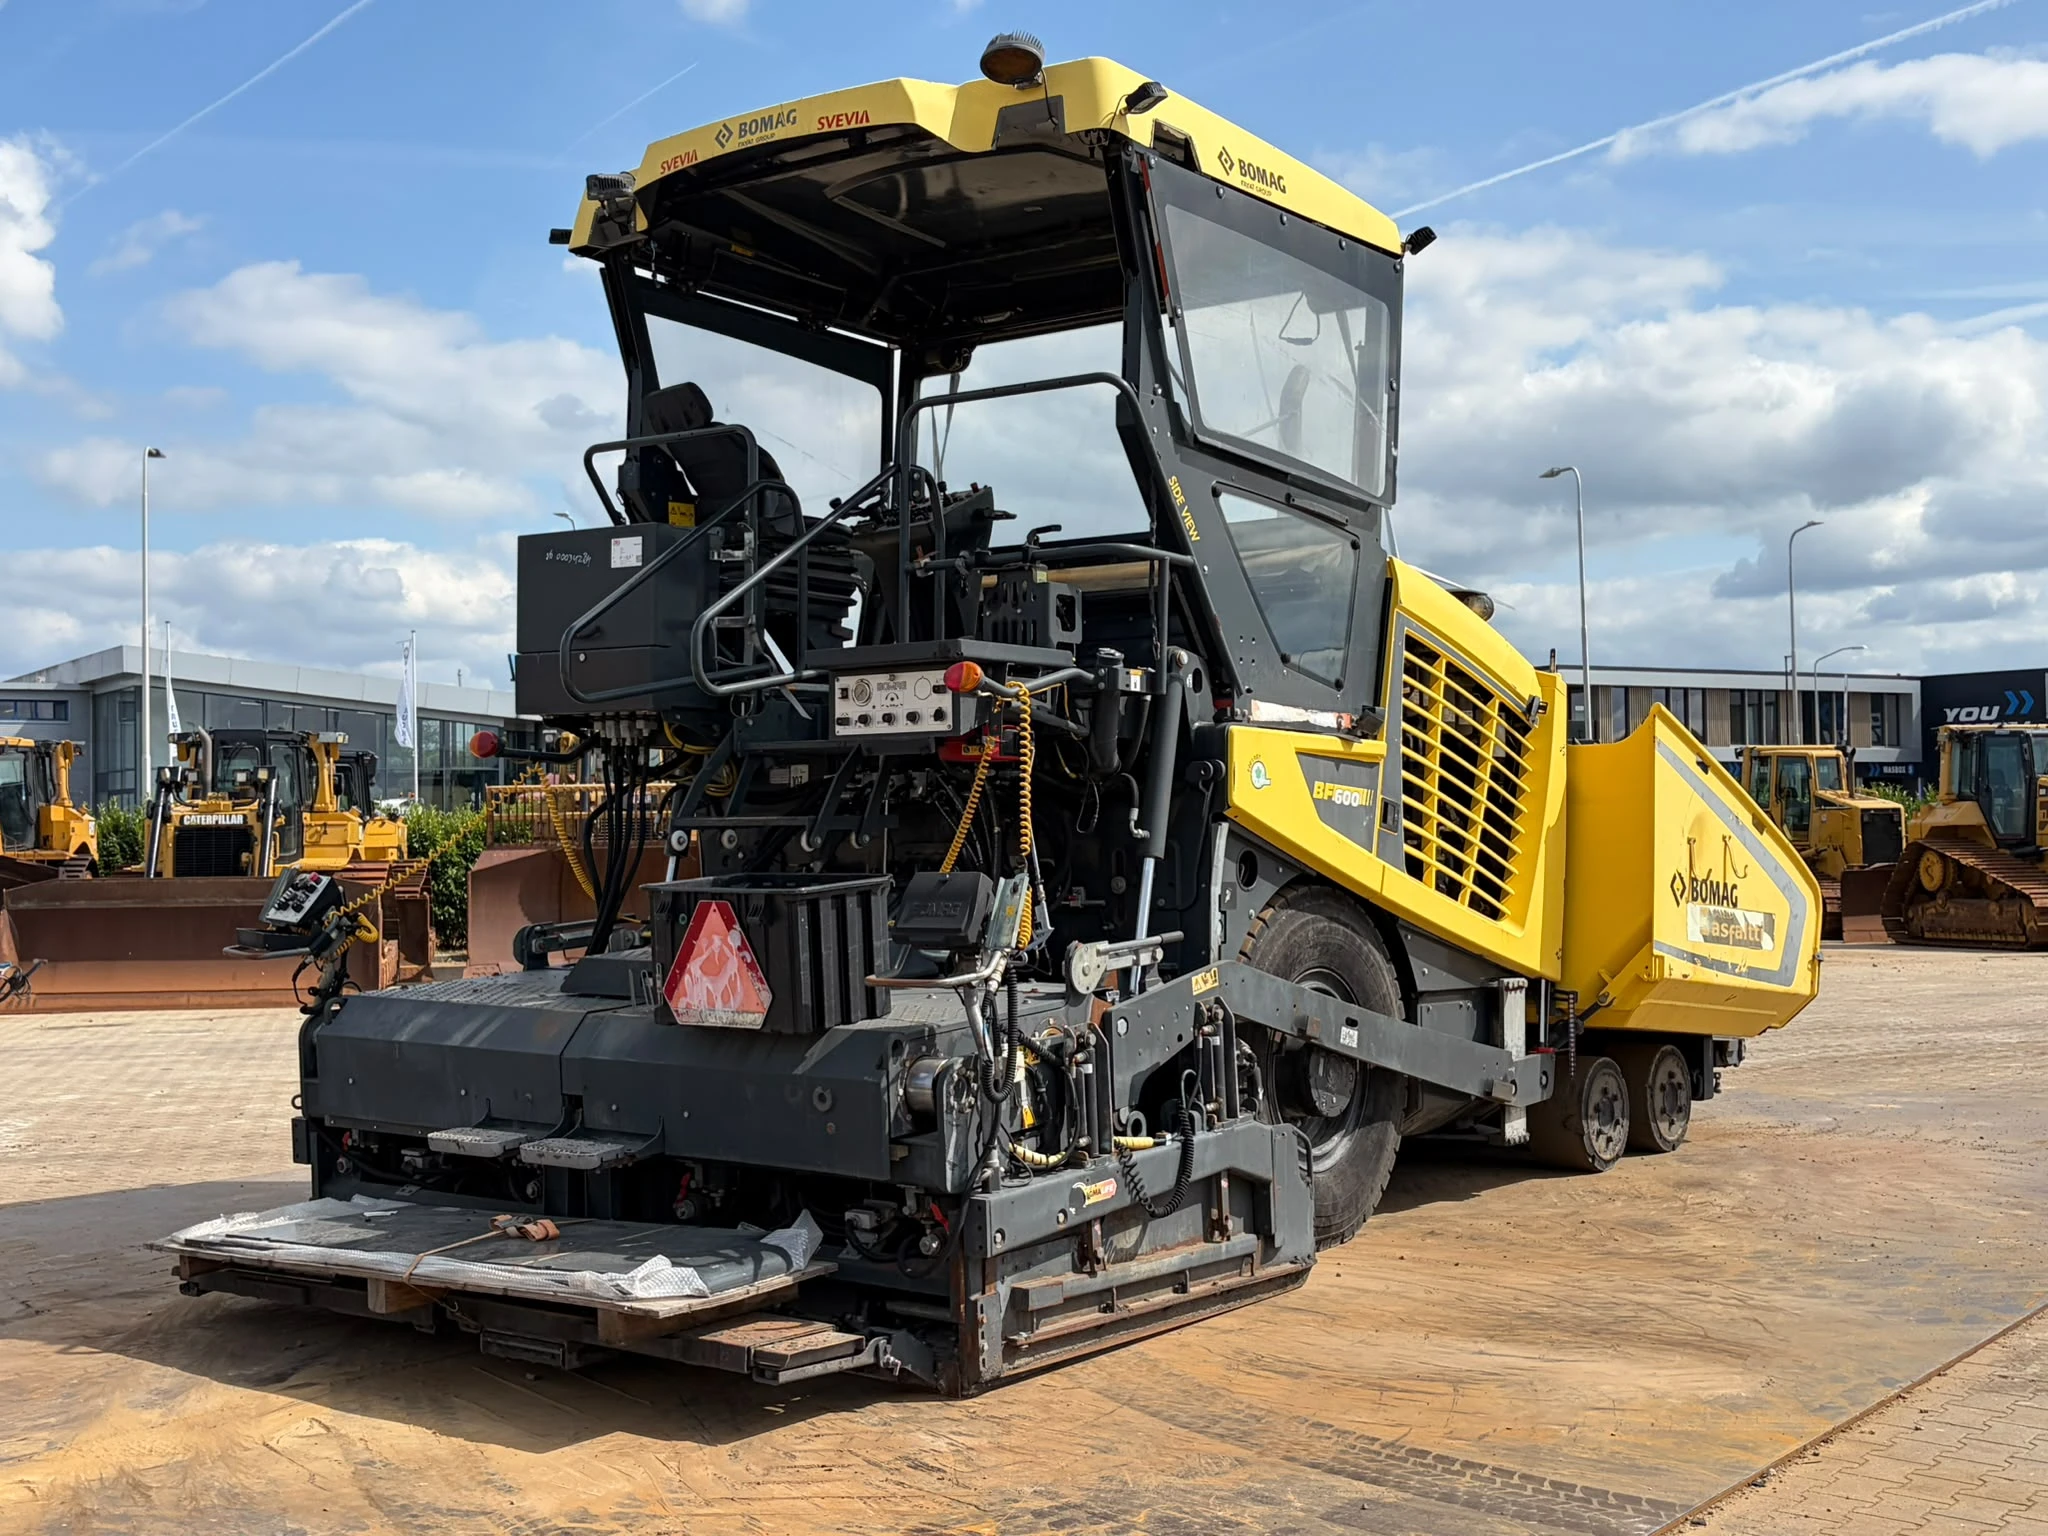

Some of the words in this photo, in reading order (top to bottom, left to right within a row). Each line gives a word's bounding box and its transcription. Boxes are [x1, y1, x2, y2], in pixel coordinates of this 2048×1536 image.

[738, 109, 797, 139] BOMAG
[817, 110, 870, 131] SVEVIA
[660, 149, 698, 175] SVEVIA
[1238, 158, 1287, 194] BOMAG
[1168, 475, 1186, 506] SIDE
[1181, 505, 1200, 542] VIEW
[1944, 705, 2000, 722] YOU
[183, 814, 244, 826] CATERPILLAR
[1691, 877, 1738, 909] BOMAG
